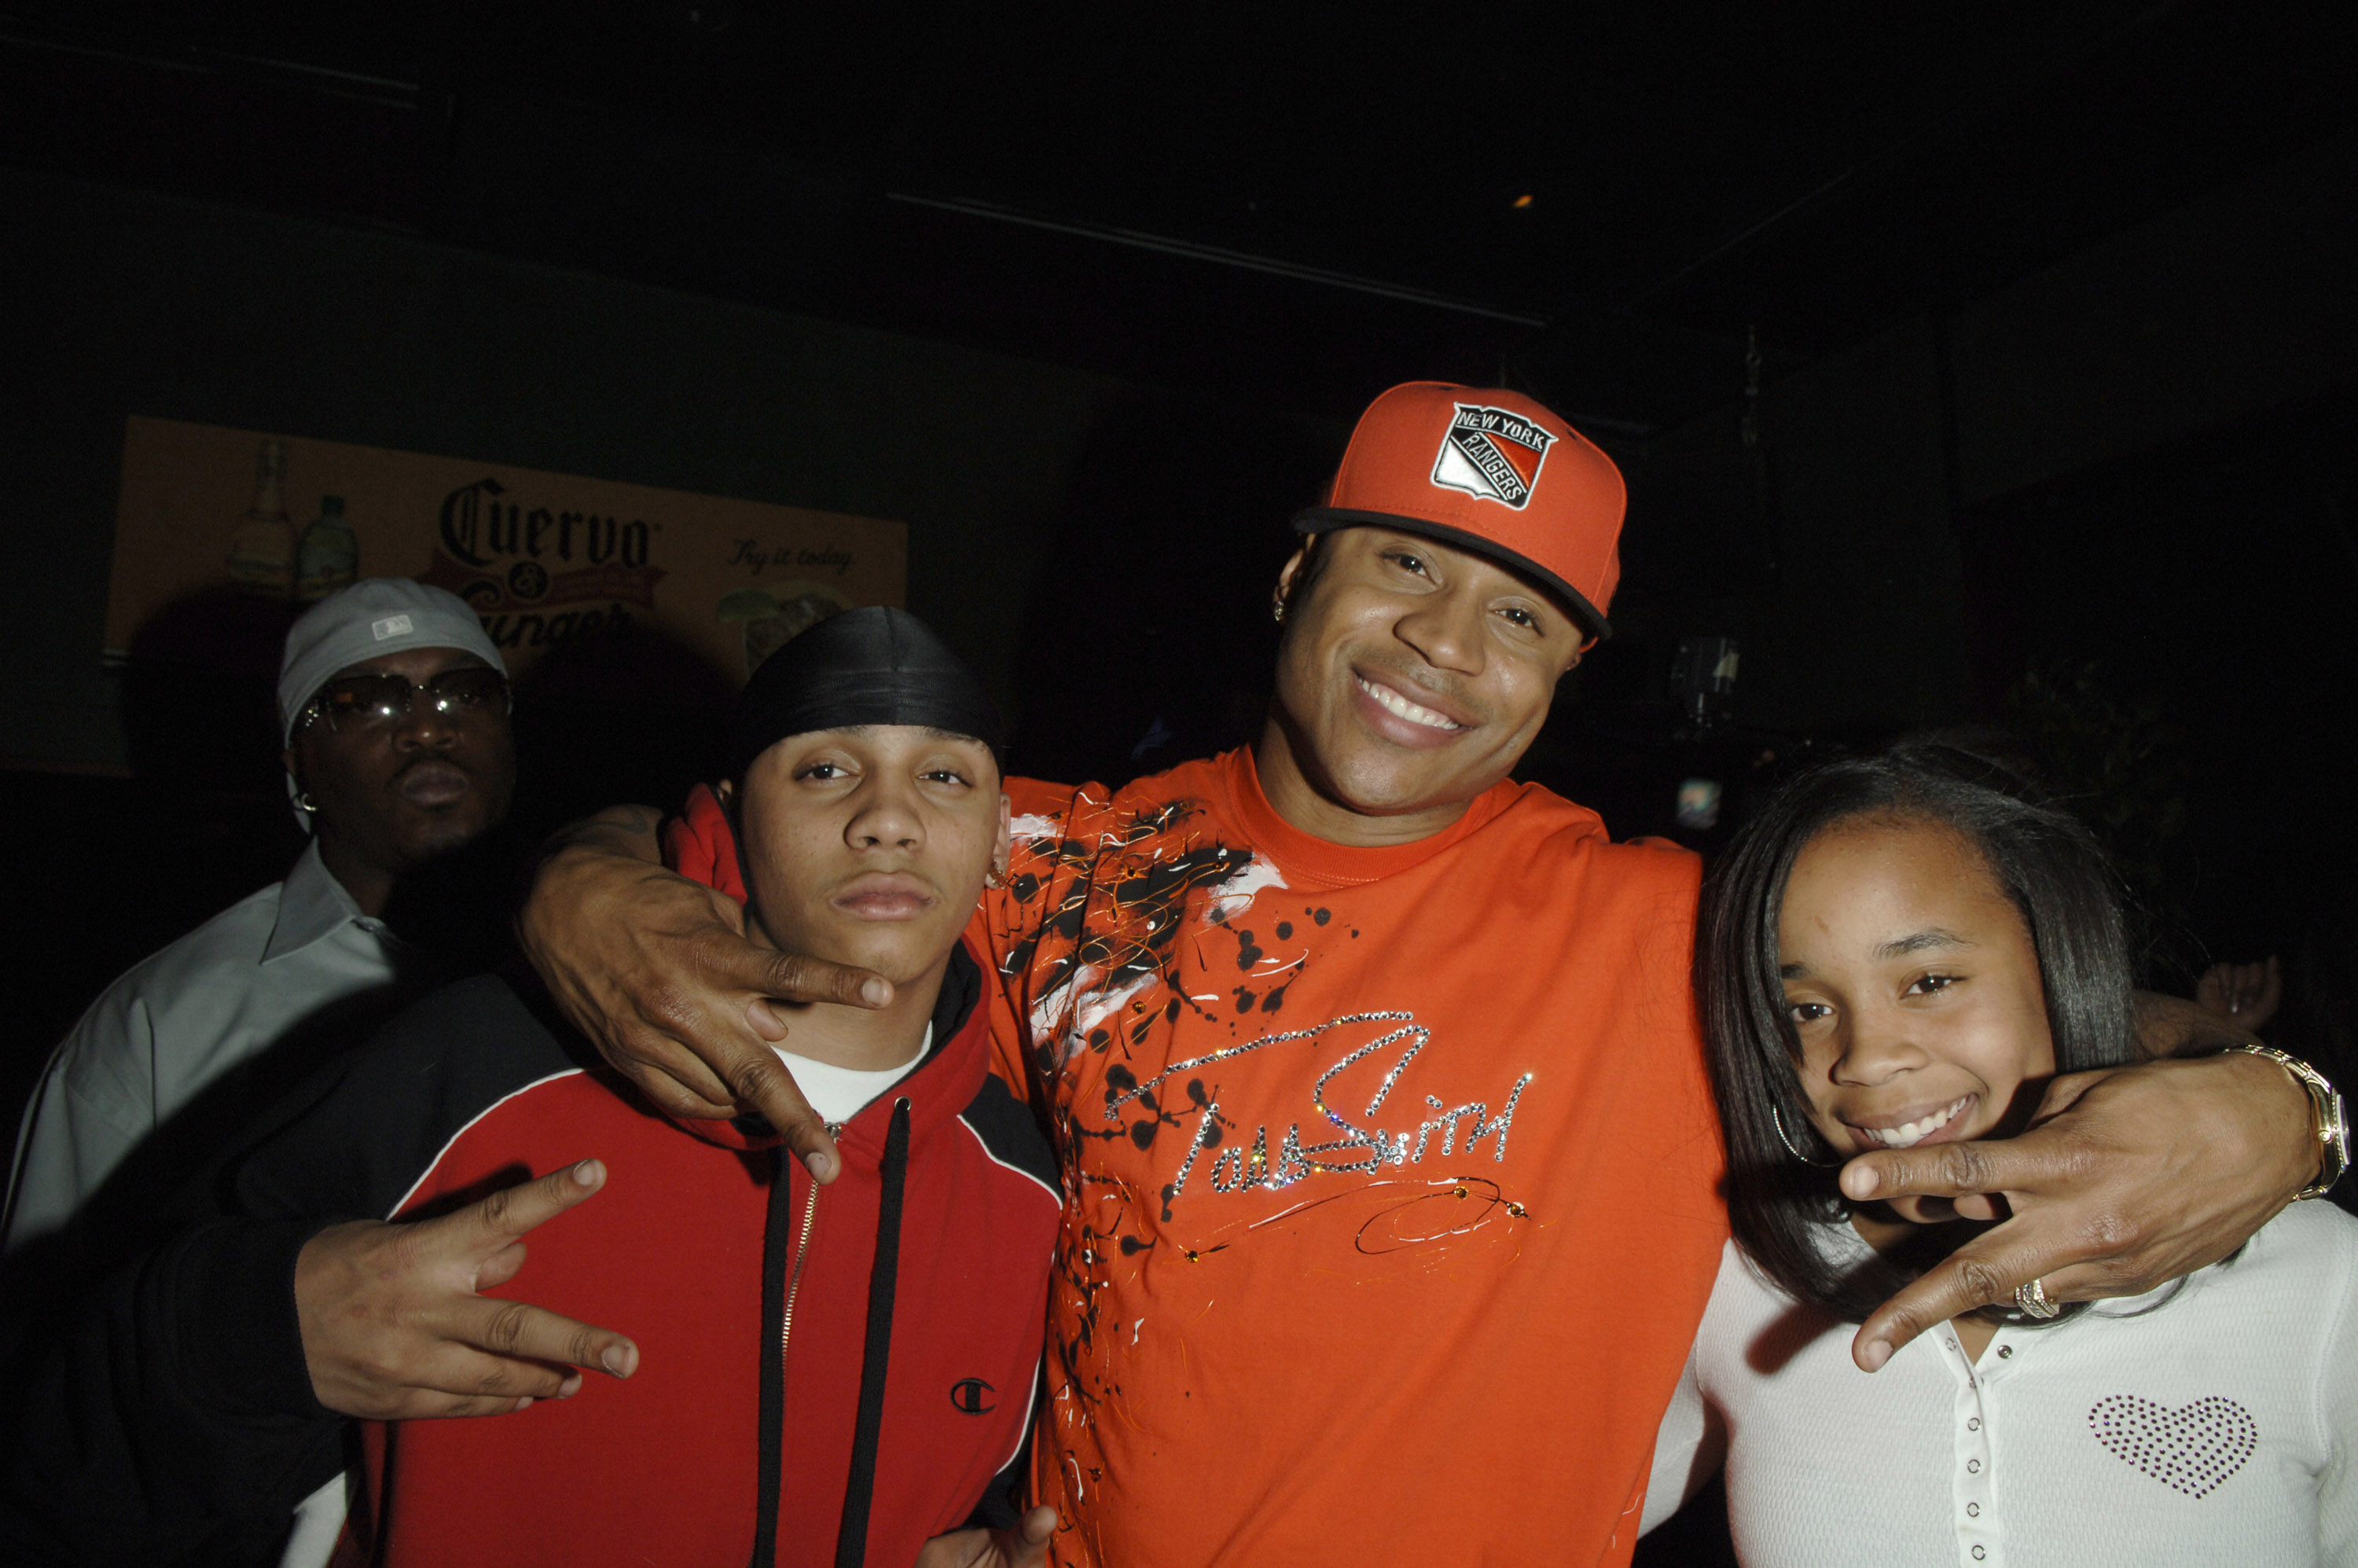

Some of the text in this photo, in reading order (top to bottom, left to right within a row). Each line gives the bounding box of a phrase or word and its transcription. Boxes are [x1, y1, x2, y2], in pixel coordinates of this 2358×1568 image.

[1456, 411, 1546, 450] NEW YORK
[1462, 431, 1522, 501] RANGERS
[440, 476, 649, 568] Cuervo
[727, 538, 768, 575] Try
[772, 546, 792, 566] it
